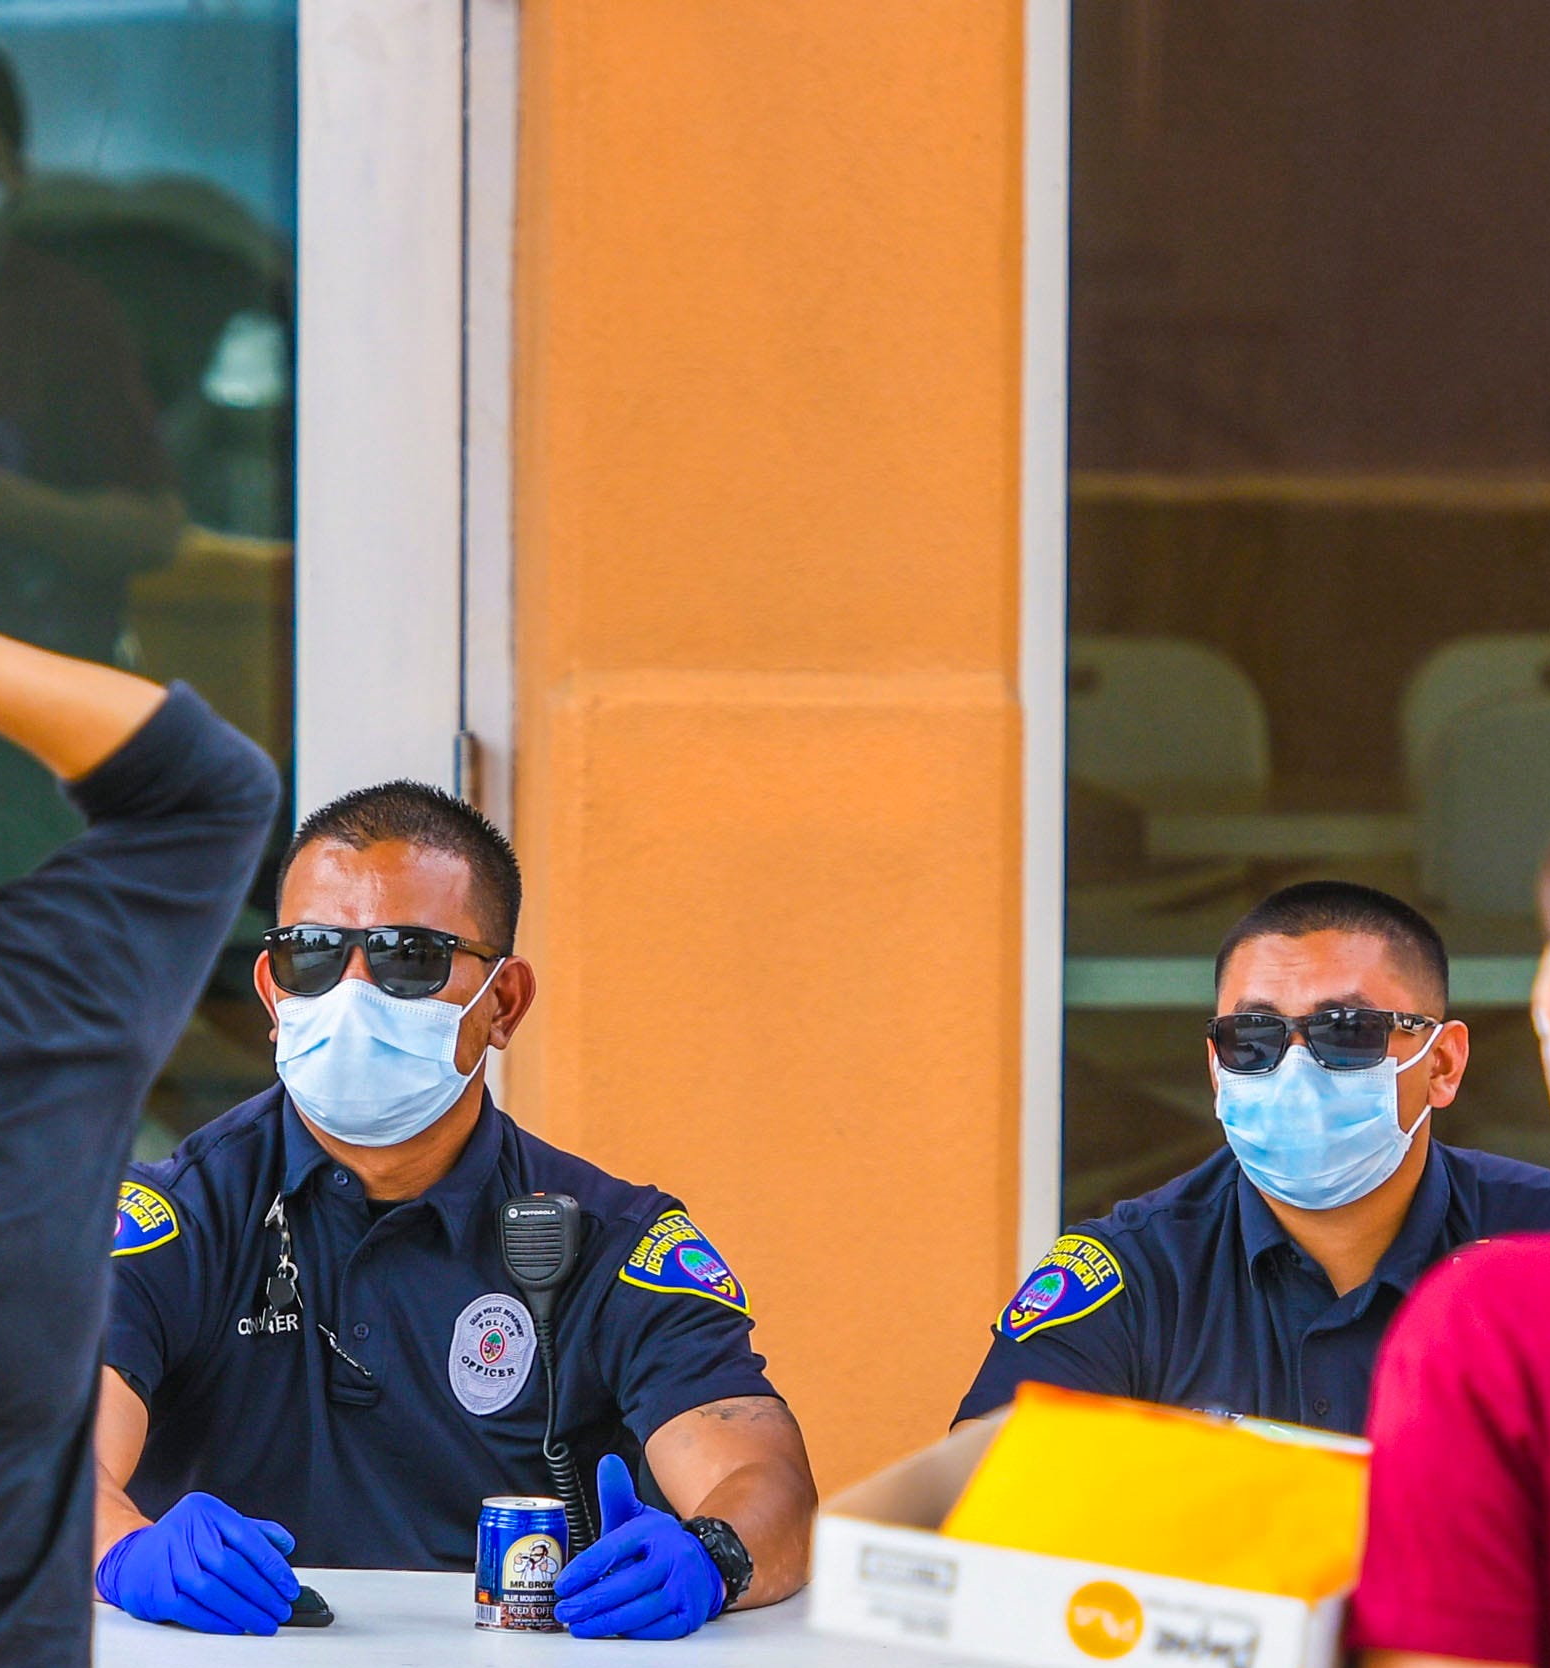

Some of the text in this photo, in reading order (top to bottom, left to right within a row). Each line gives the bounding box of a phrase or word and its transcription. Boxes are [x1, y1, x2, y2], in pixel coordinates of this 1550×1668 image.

[131, 1191, 170, 1227] POLICE
[628, 1235, 656, 1269] GUAM
[1077, 1244, 1115, 1283] POLICE
[482, 1306, 503, 1316] POLICE
[478, 1319, 517, 1339] POLICE
[461, 1355, 516, 1378] OFFICER
[503, 1594, 518, 1602] BLUE
[519, 1594, 547, 1602] MOUNTAIN
[508, 1606, 529, 1615] ICED
